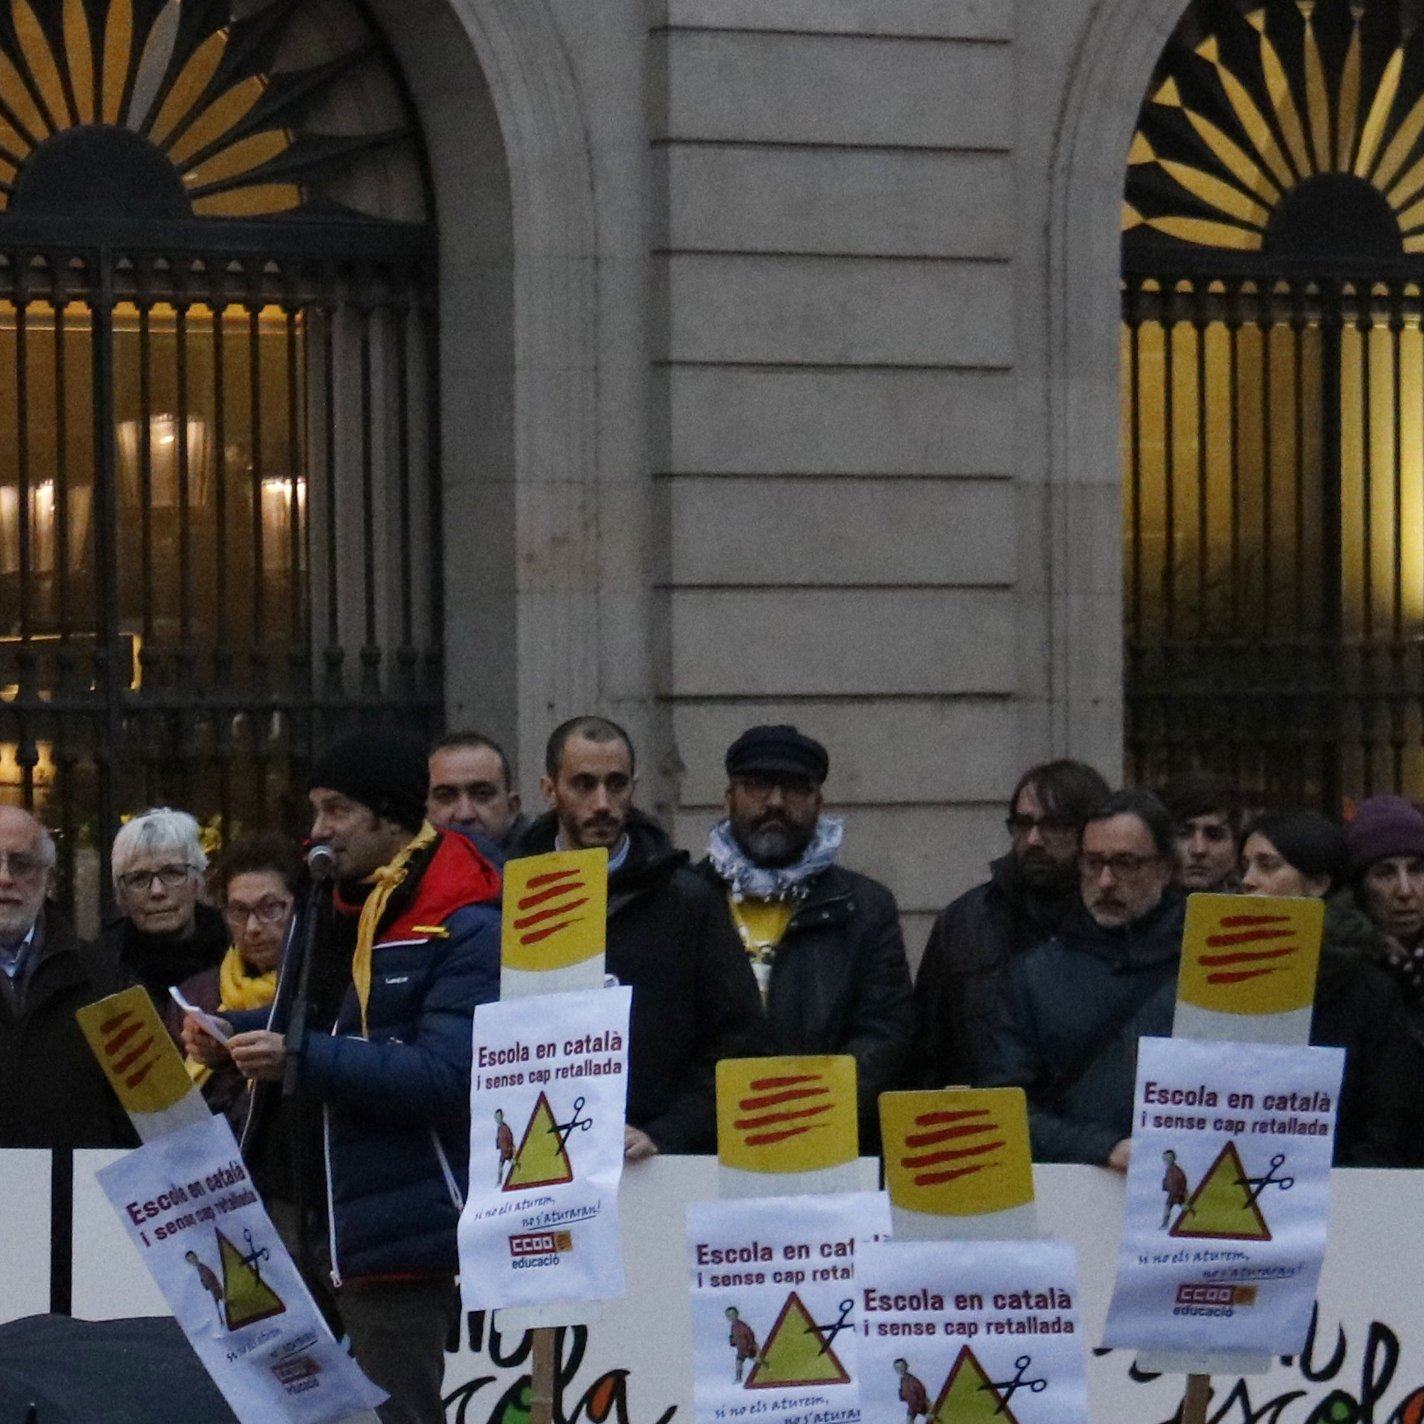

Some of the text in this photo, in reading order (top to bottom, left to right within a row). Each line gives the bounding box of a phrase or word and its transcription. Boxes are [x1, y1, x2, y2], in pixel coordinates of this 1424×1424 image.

[478, 1031, 623, 1068] Escola en català
[476, 1058, 622, 1090] i sense cap retallada
[1143, 1081, 1331, 1113] Escola en català
[1141, 1111, 1328, 1136] i sense cap retallada
[140, 1231, 151, 1247] i
[512, 1254, 560, 1270] educació
[696, 1238, 855, 1266] Escola en cat
[698, 1272, 703, 1288] i
[710, 1272, 765, 1287] sense
[773, 1270, 805, 1286] cap
[863, 1287, 1072, 1312] Escola en català
[1173, 1306, 1233, 1318] educació
[864, 1317, 1075, 1338] i sense cap retallada
[729, 1407, 747, 1417] no
